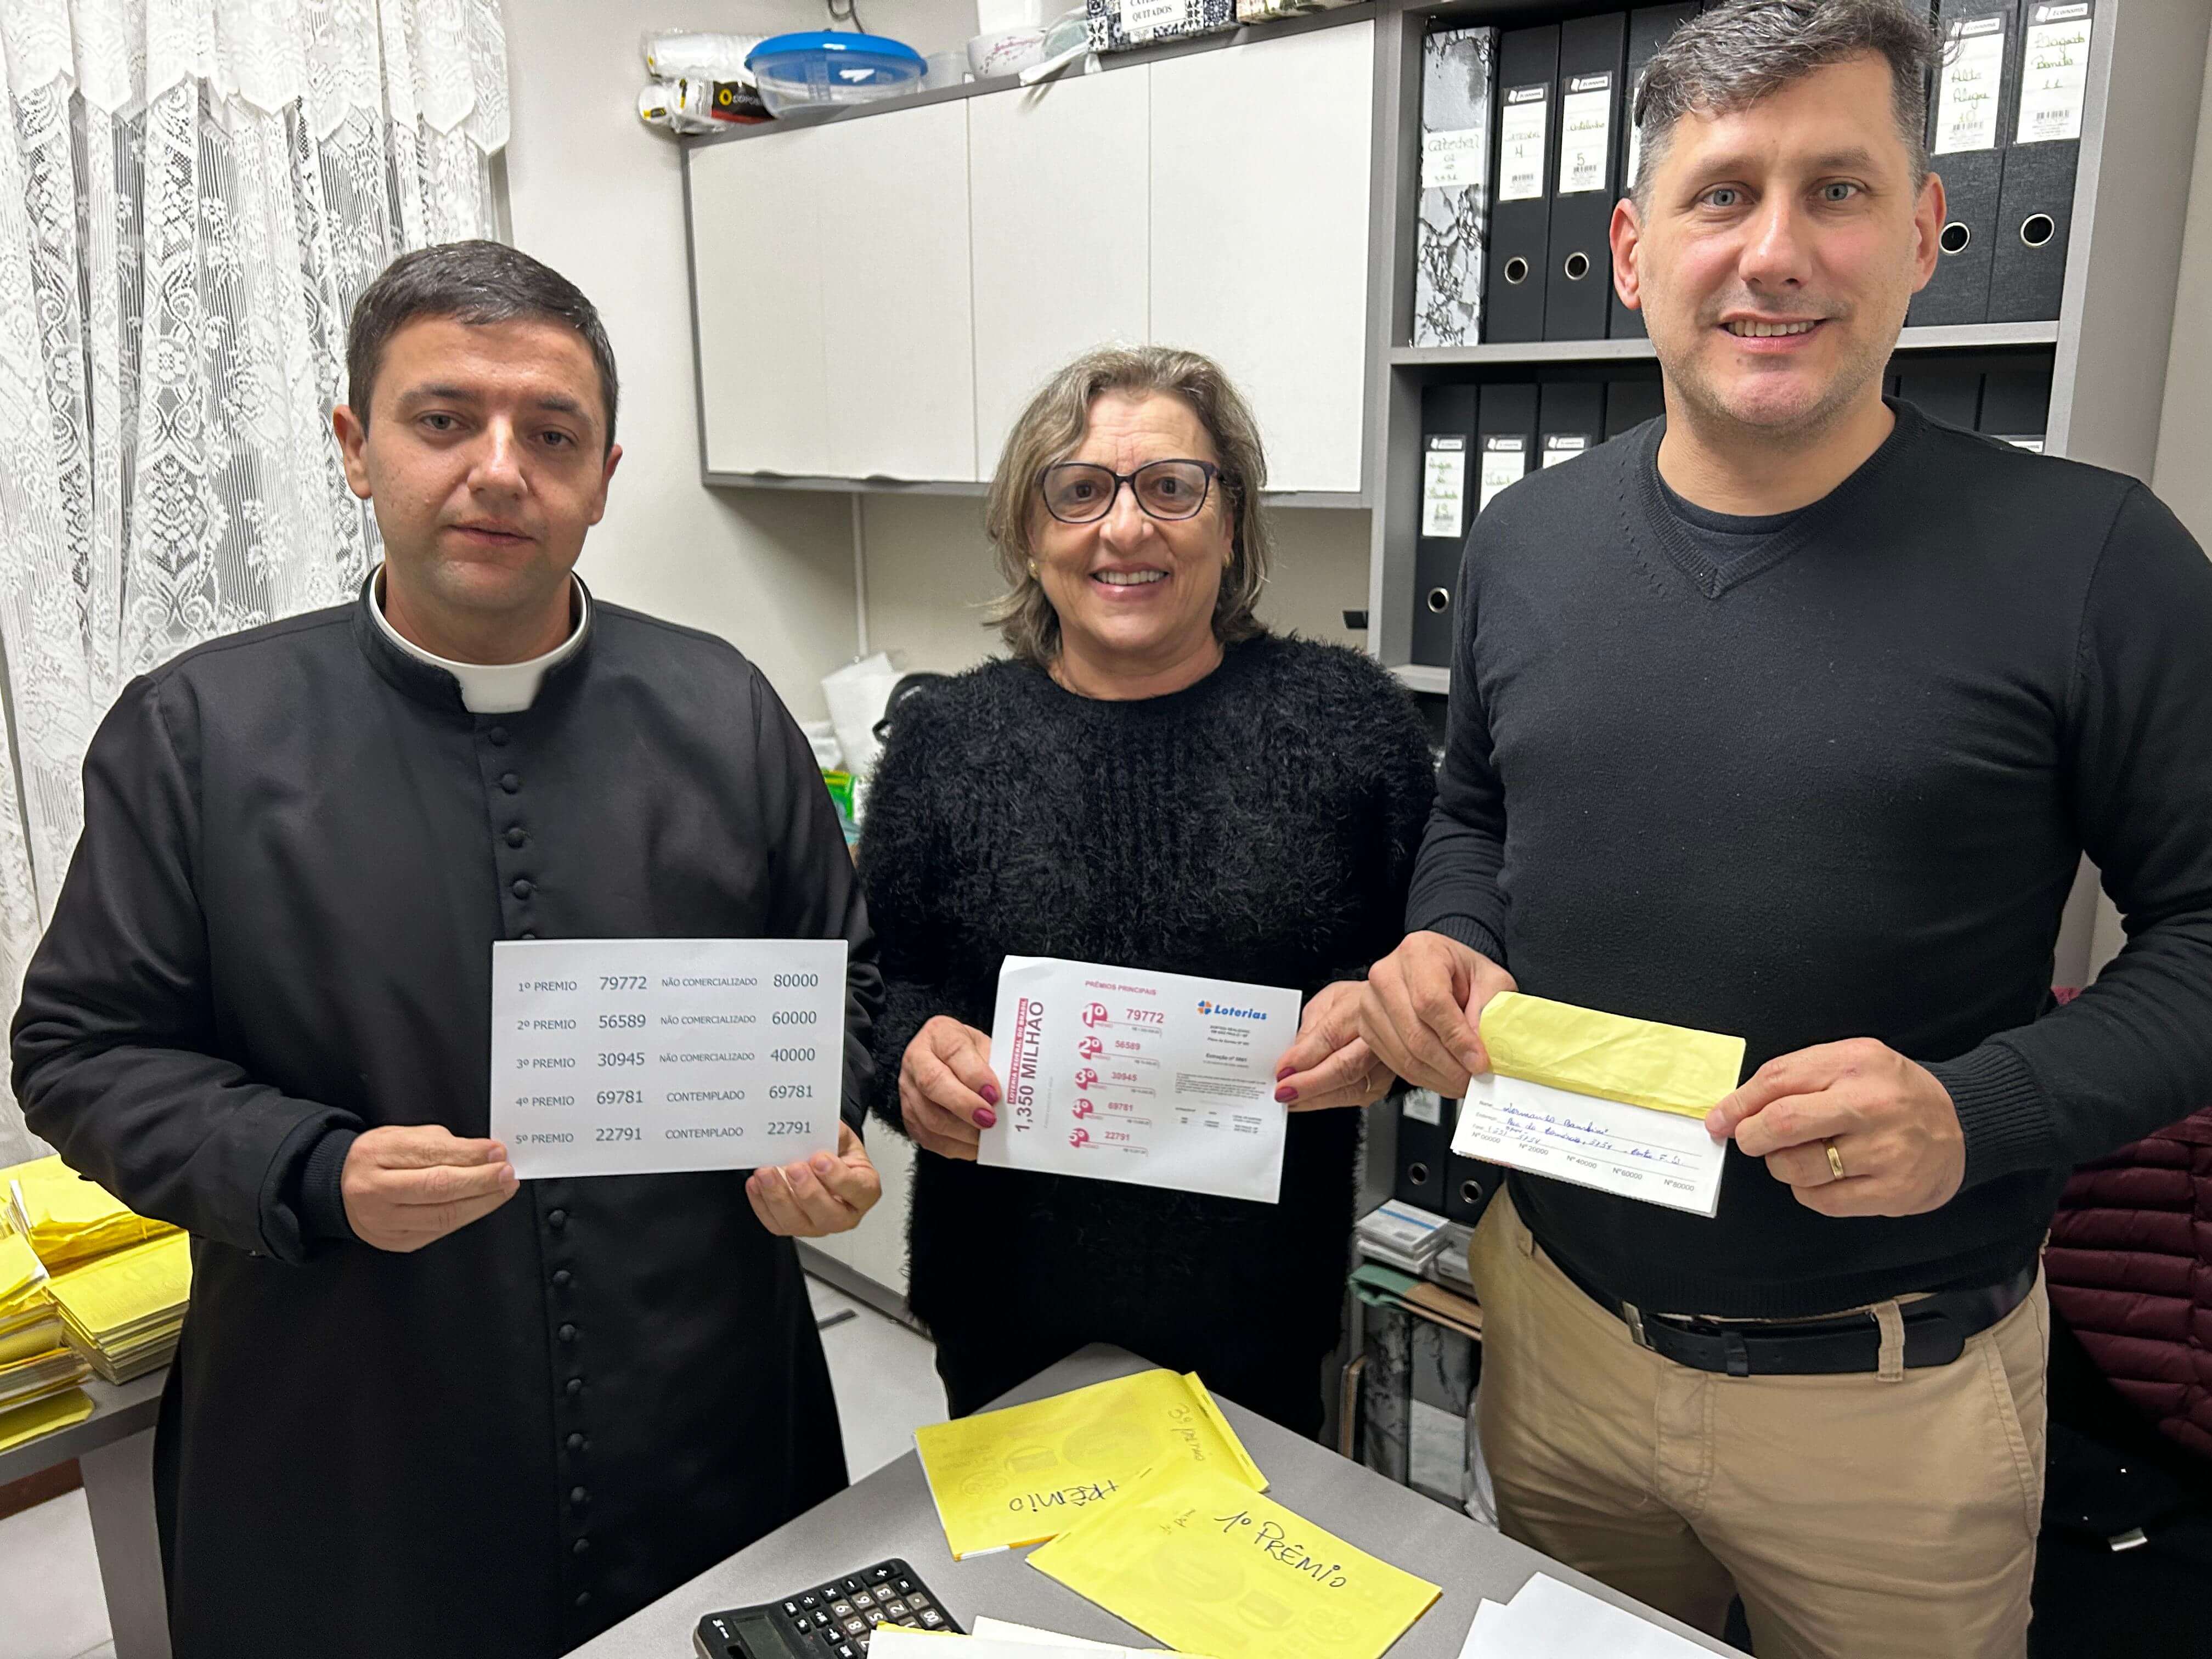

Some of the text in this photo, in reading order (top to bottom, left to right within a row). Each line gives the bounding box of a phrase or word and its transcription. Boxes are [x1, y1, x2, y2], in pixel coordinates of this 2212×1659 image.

[1577, 153, 1585, 166] 5
[518, 974, 819, 992] 1º PREMIO 79772 NÃO COMERCIALIZADO 80000
[1118, 985, 1156, 996] PRINCIPAIS
[517, 1011, 817, 1030] 2º PREMIO 56589 NÃO COMERCIALIZADO 60000
[1082, 1004, 1164, 1025] 1º 79772
[1214, 1005, 1267, 1020] Loterias
[1079, 1037, 1099, 1053] 2º
[516, 1047, 816, 1069] 3º PREMIO 30945 NÃO COMERCIALIZADO 40000
[1012, 1039, 1022, 1071] FEDERAL
[1075, 1070, 1094, 1084] 3º
[515, 1085, 813, 1107] 4º PREMIO 69781 CONTEMPLADO 69781
[1014, 1085, 1035, 1133] 1,350
[515, 1121, 811, 1144] 5º PREMIO 22791 CONTEMPLADO 22791
